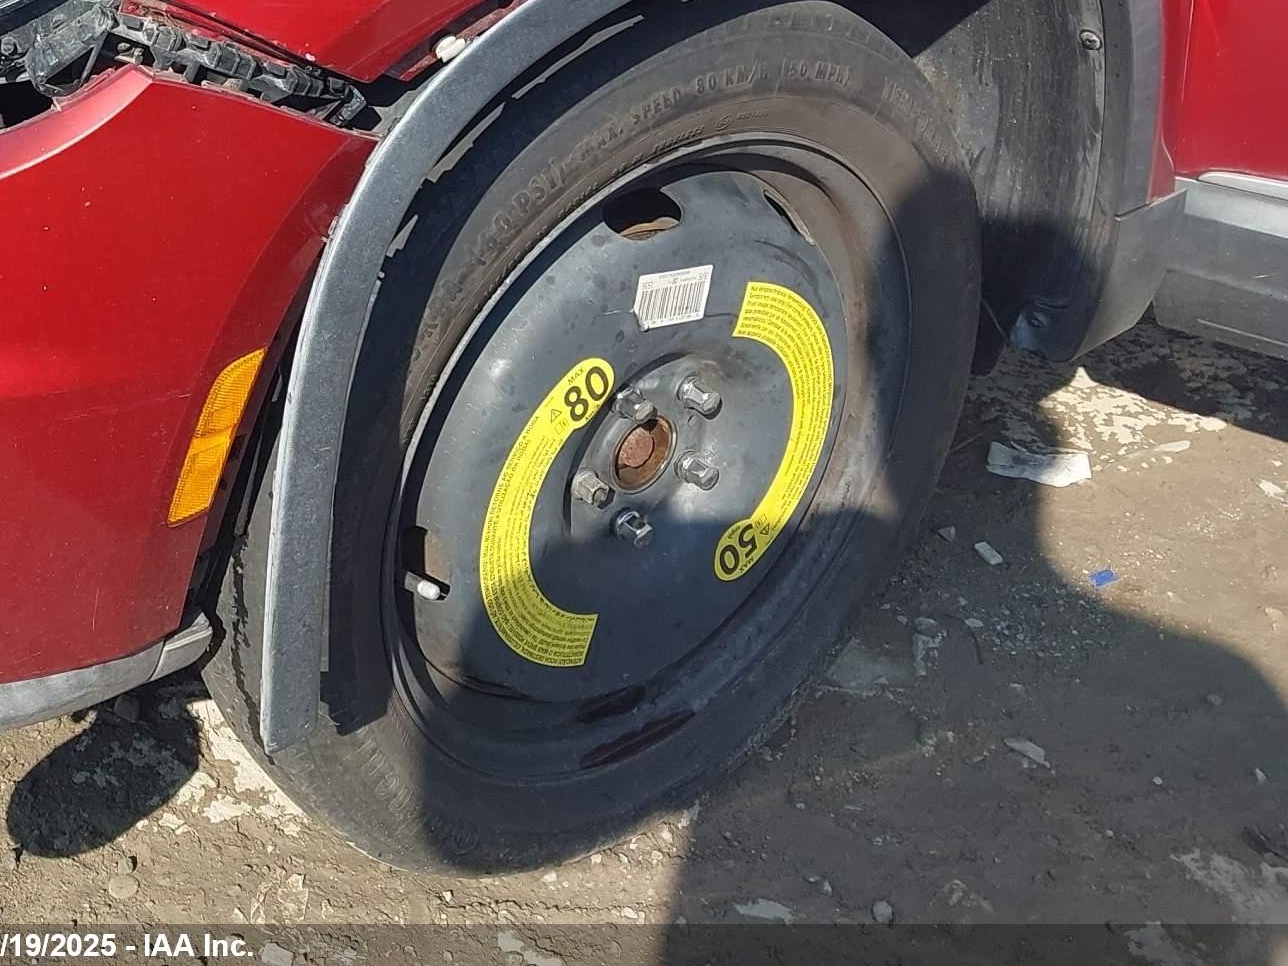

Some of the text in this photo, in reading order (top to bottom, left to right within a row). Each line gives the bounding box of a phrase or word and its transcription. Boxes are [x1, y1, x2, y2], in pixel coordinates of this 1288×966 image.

[567, 366, 584, 385] MAX
[564, 365, 609, 422] 80
[719, 523, 757, 575] 50
[738, 557, 755, 573] MAX
